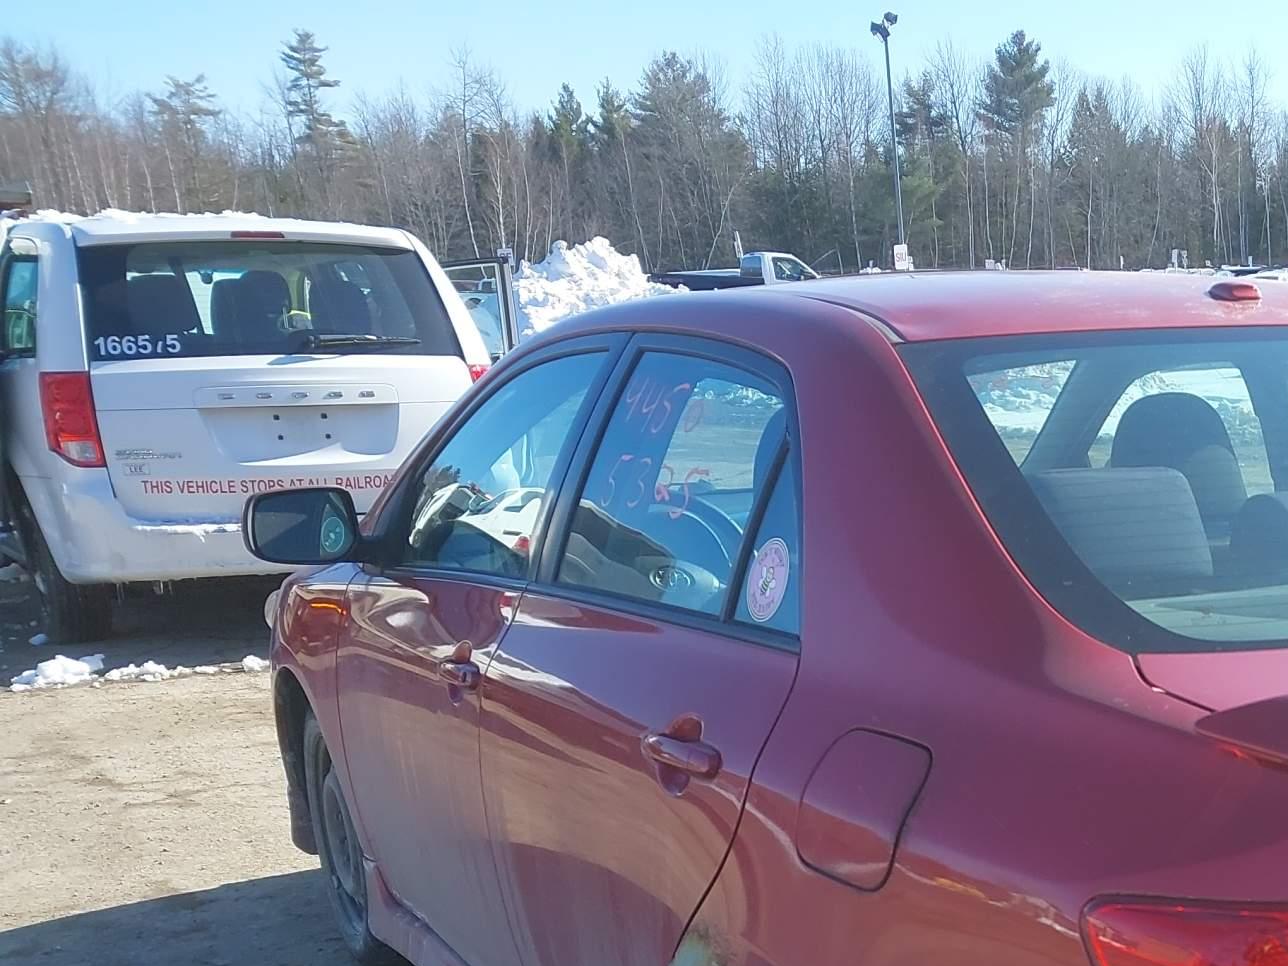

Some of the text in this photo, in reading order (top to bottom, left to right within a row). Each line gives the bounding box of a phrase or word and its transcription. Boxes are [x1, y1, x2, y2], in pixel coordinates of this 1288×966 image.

[141, 480, 174, 494] THIS
[176, 480, 237, 494] VEHICLE
[240, 479, 284, 493] STOPS
